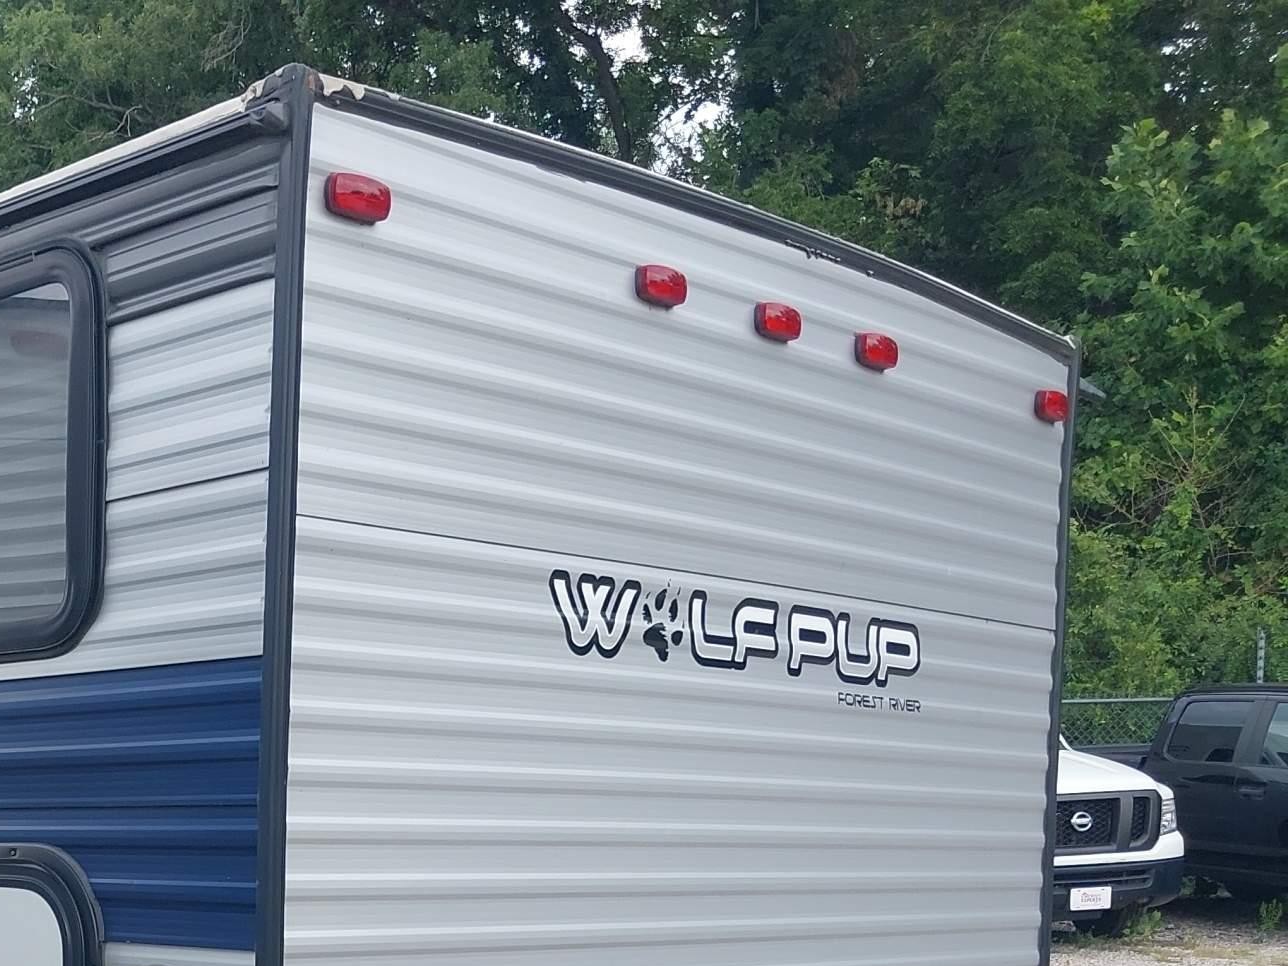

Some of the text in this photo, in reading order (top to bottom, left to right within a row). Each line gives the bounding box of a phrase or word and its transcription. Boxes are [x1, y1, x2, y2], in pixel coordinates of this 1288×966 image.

[787, 604, 921, 688] PUP
[837, 691, 922, 713] FOREST RIVER
